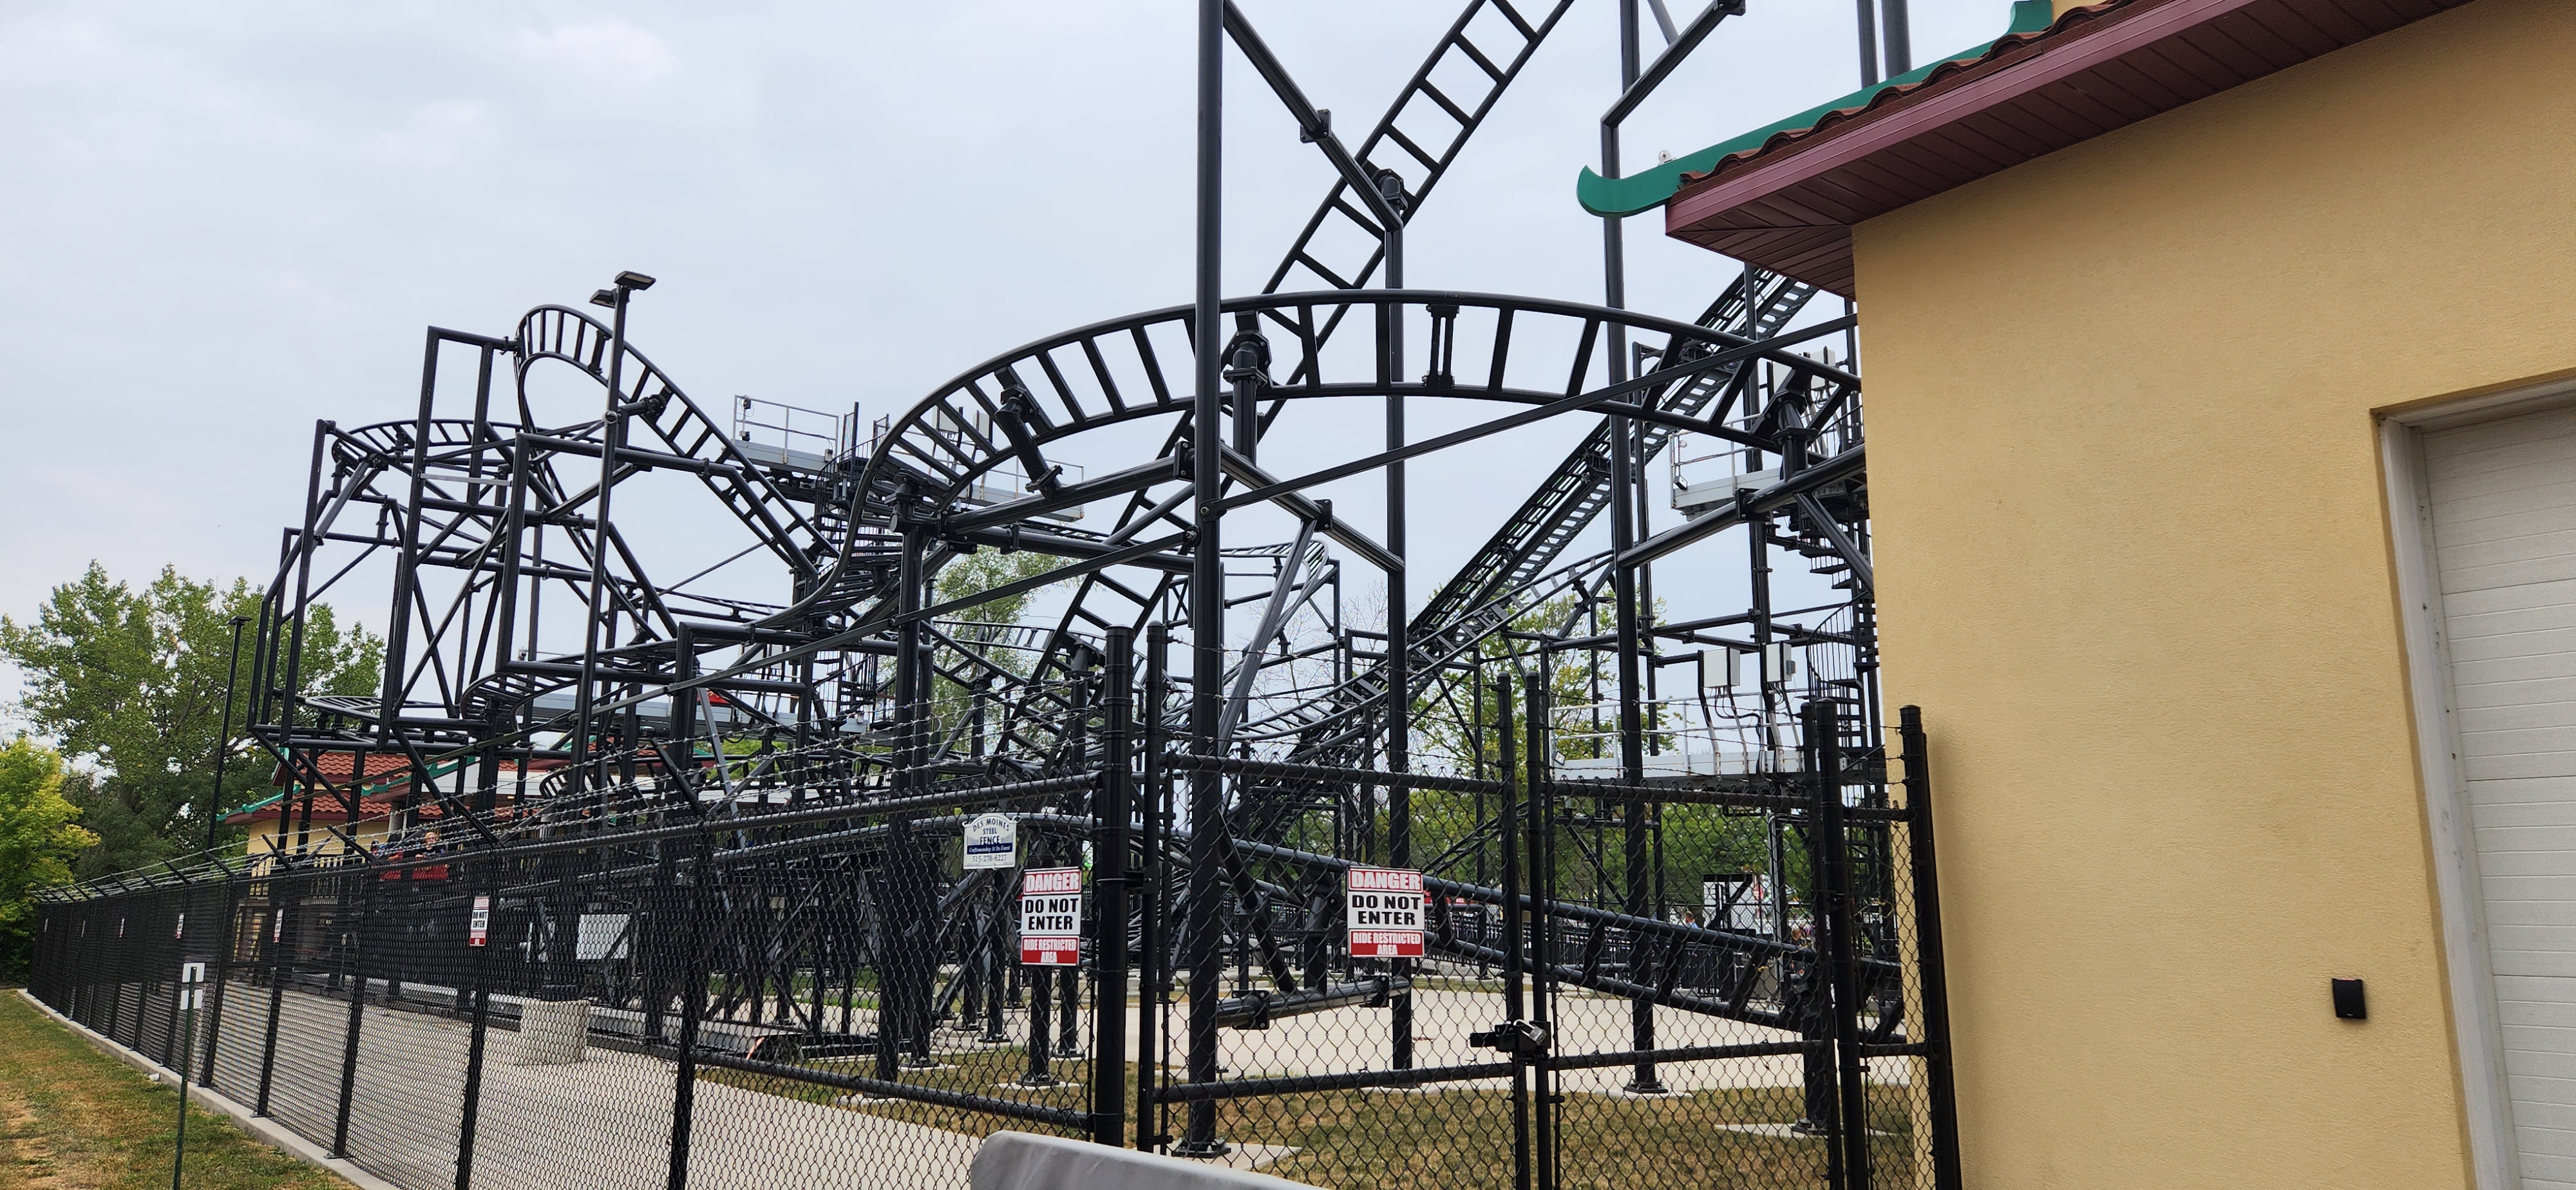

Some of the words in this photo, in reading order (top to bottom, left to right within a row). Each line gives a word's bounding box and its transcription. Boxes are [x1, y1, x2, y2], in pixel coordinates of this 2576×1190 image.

[973, 820, 983, 832] DES
[986, 818, 1009, 831] MOINES
[980, 836, 1000, 845] FENCE
[1026, 873, 1079, 892] DANGER
[1351, 871, 1421, 890] DANGER
[1025, 899, 1045, 913] DO
[1049, 898, 1079, 912] NOT
[1352, 895, 1378, 909] DO
[1385, 896, 1421, 910] NOT
[1028, 916, 1073, 930] ENTER
[1358, 911, 1415, 925] ENTER
[1023, 939, 1037, 951] RIDE
[1038, 939, 1076, 951] RESTRICTED
[1353, 932, 1372, 943] RIDE
[1373, 932, 1421, 944] RESTRICTED
[1377, 944, 1398, 955] AREA
[1041, 952, 1057, 963] AREA
